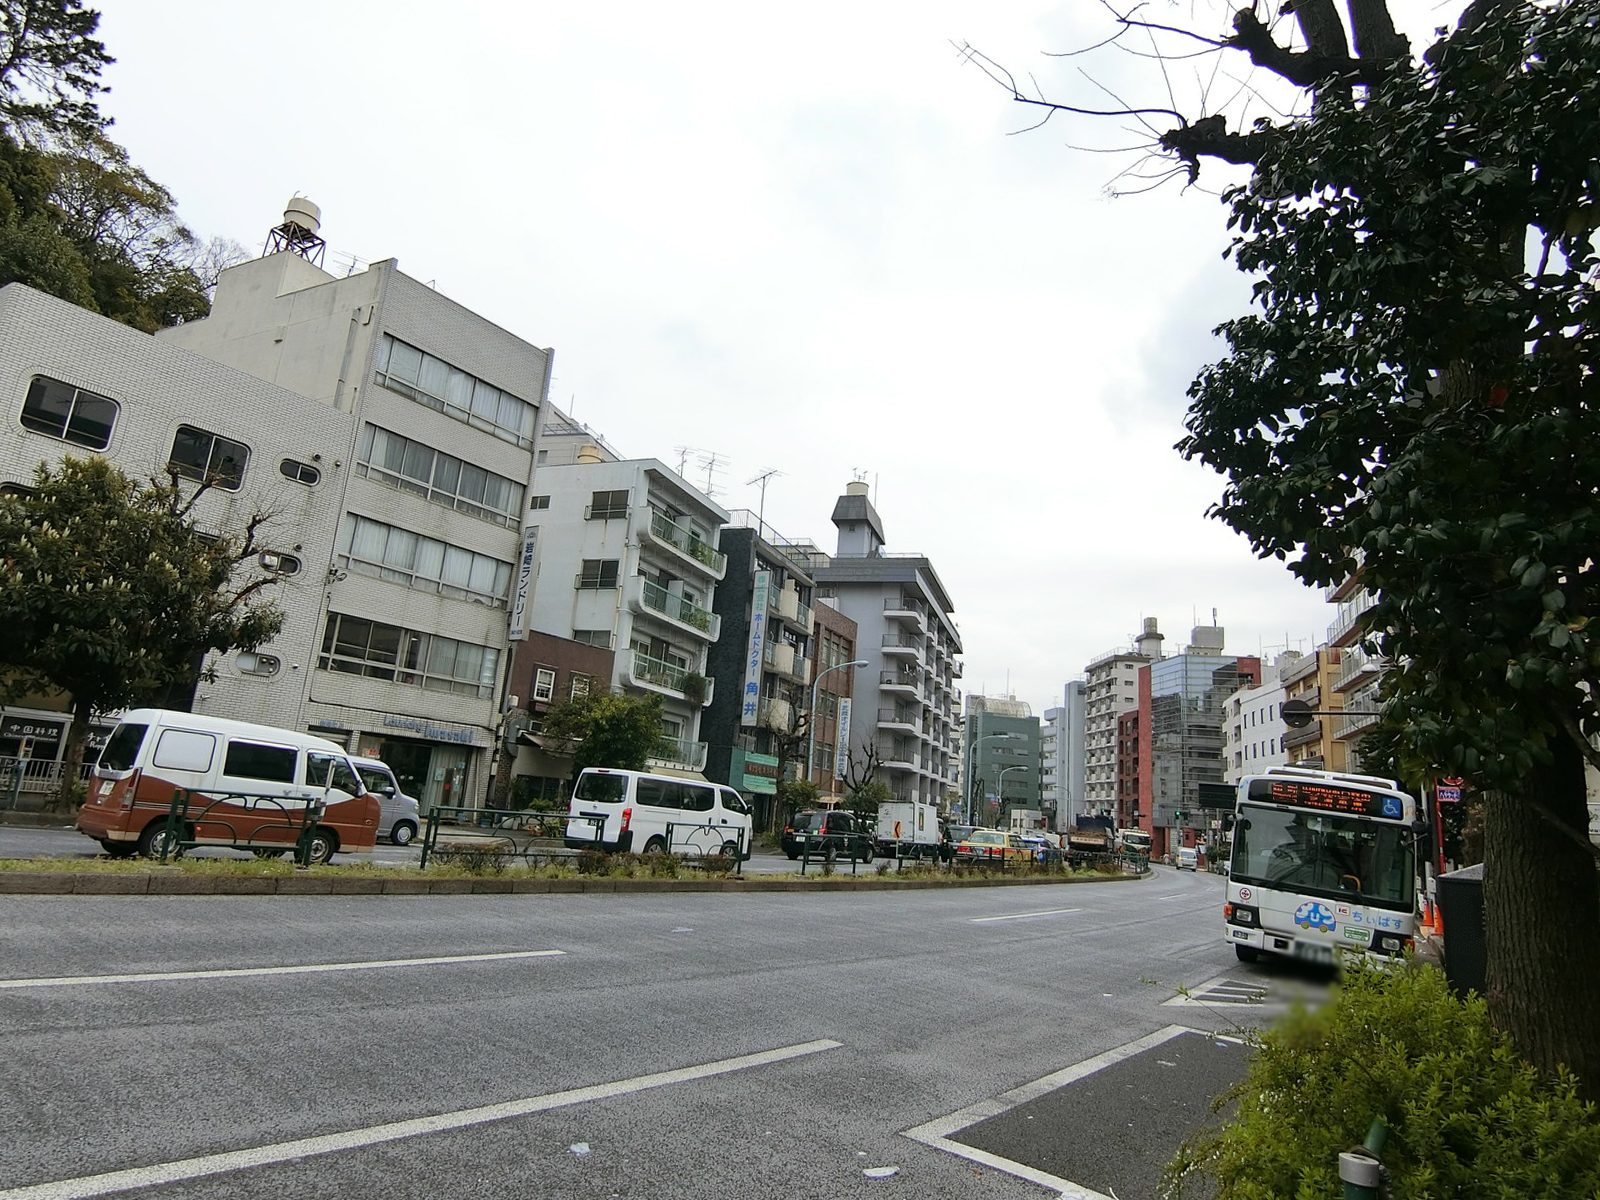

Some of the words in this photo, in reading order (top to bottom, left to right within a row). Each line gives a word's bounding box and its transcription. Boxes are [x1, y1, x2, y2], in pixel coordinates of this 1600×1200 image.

[743, 682, 759, 716] 角井
[10, 724, 58, 737] 中国料理
